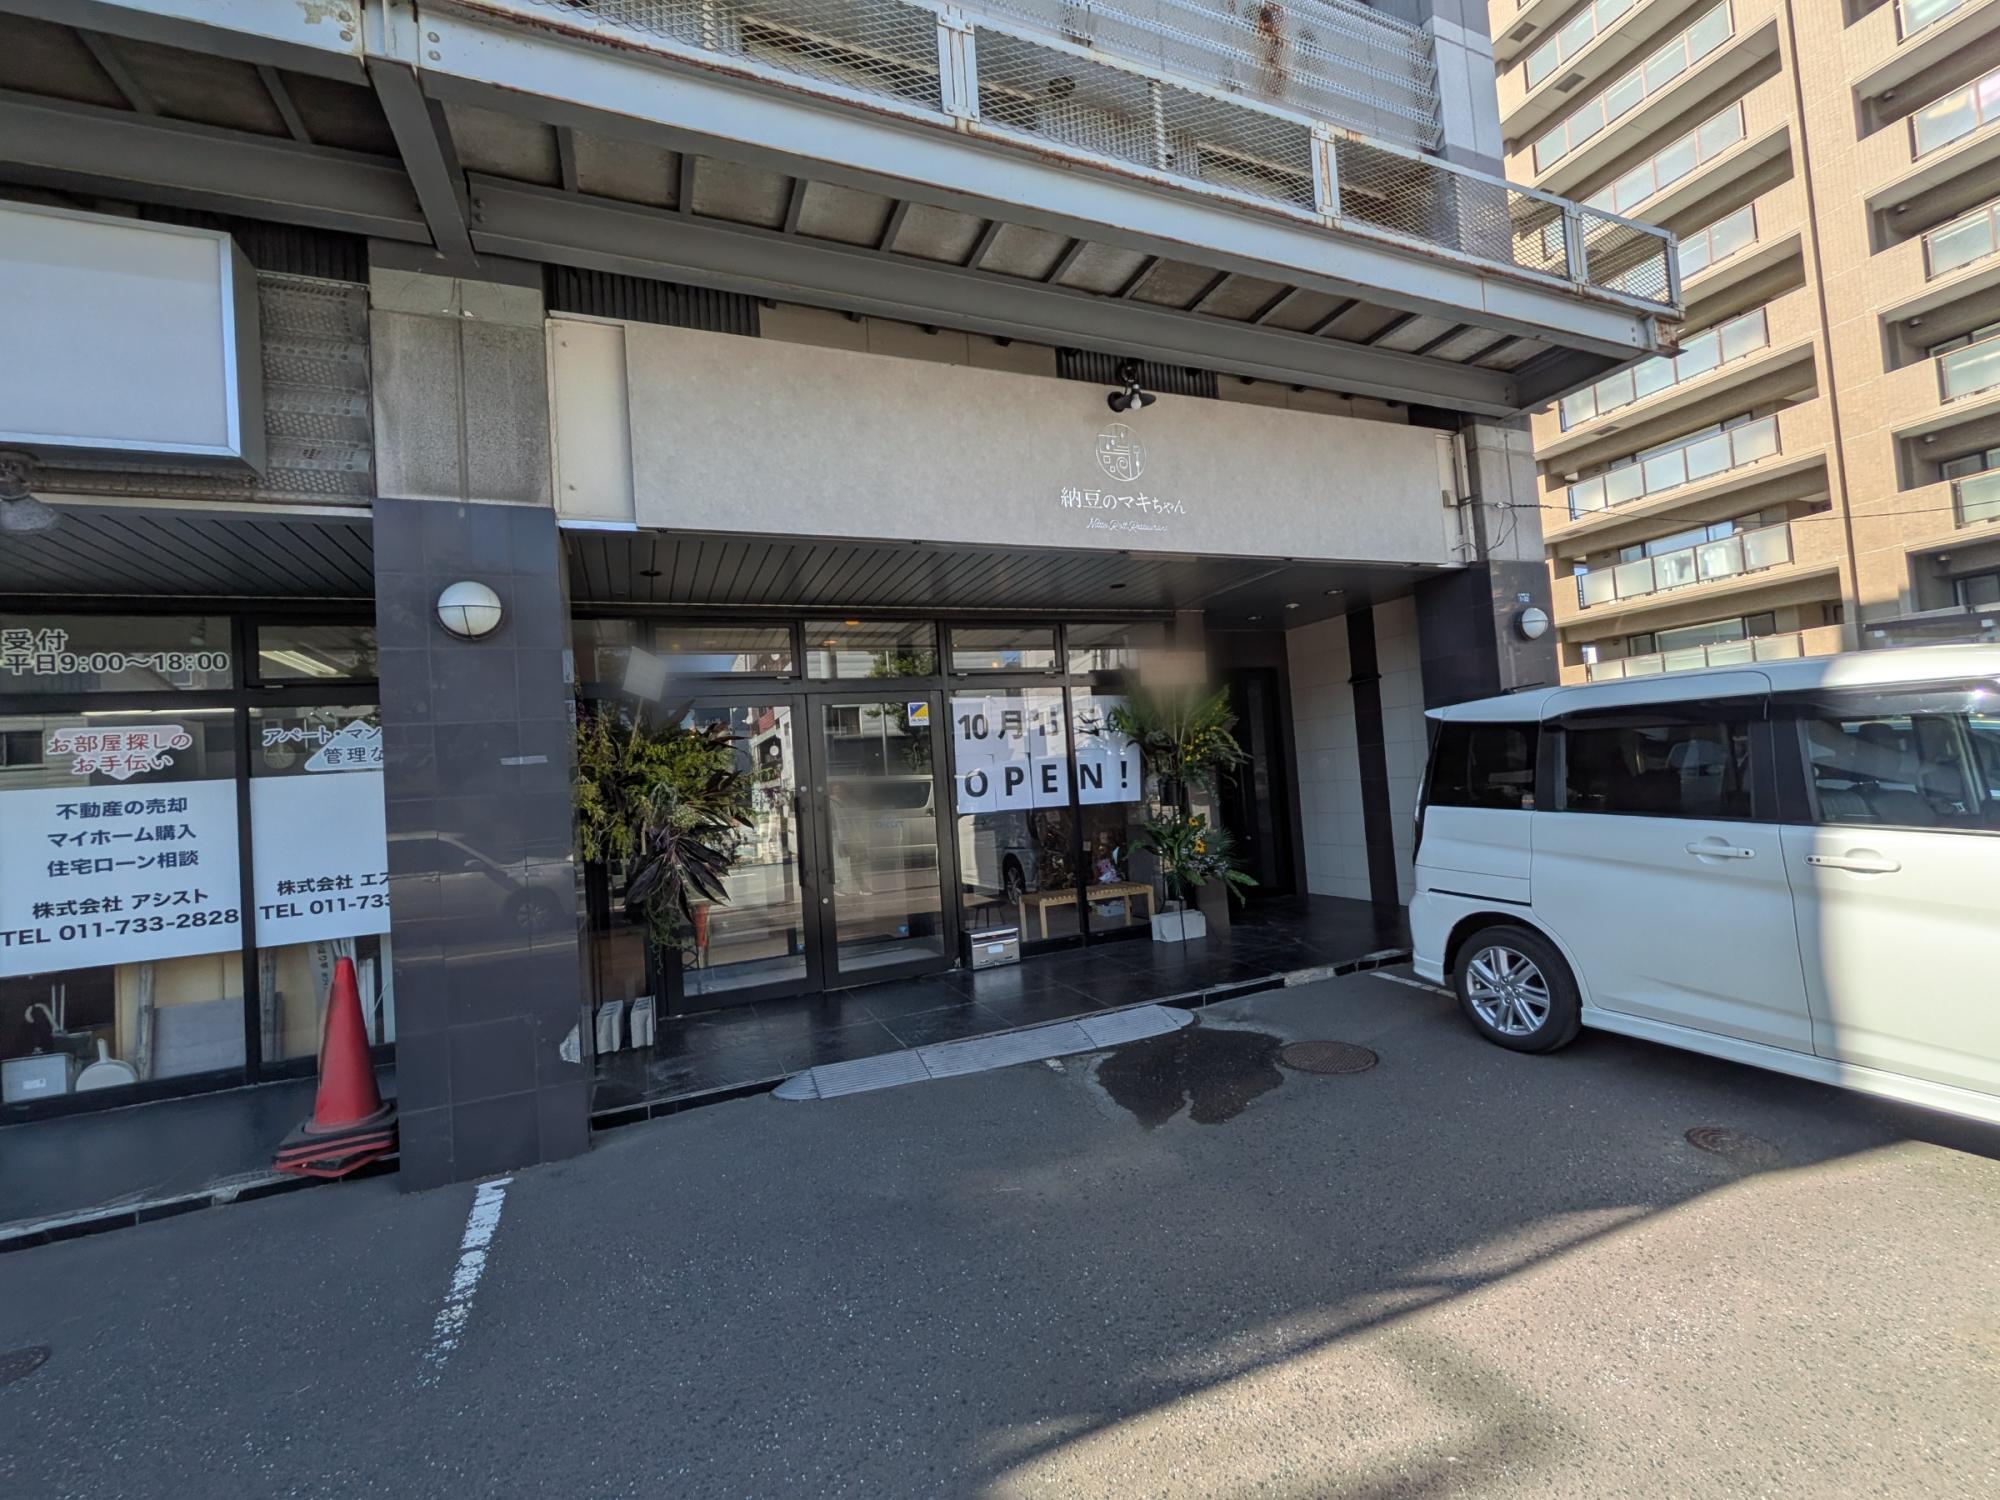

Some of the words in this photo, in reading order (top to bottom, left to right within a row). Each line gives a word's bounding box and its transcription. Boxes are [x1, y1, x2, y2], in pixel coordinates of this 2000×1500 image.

[1060, 486, 1187, 514] 納豆のマキちゃん
[2, 629, 68, 653] 受付
[49, 731, 192, 755] お部屋探しの
[73, 752, 174, 774] お手伝い
[964, 760, 1129, 798] OPEN!
[55, 797, 189, 820] 不動産の売却
[47, 823, 197, 848] マイホーム購入
[47, 849, 200, 877] 住宅ローン相談
[276, 873, 354, 896] 株式会社
[32, 895, 123, 920] 株式会社
[131, 888, 209, 910] アシスト
[259, 902, 304, 920] TEL
[0, 926, 51, 947] TEL
[59, 908, 240, 942] 011-733-2828
